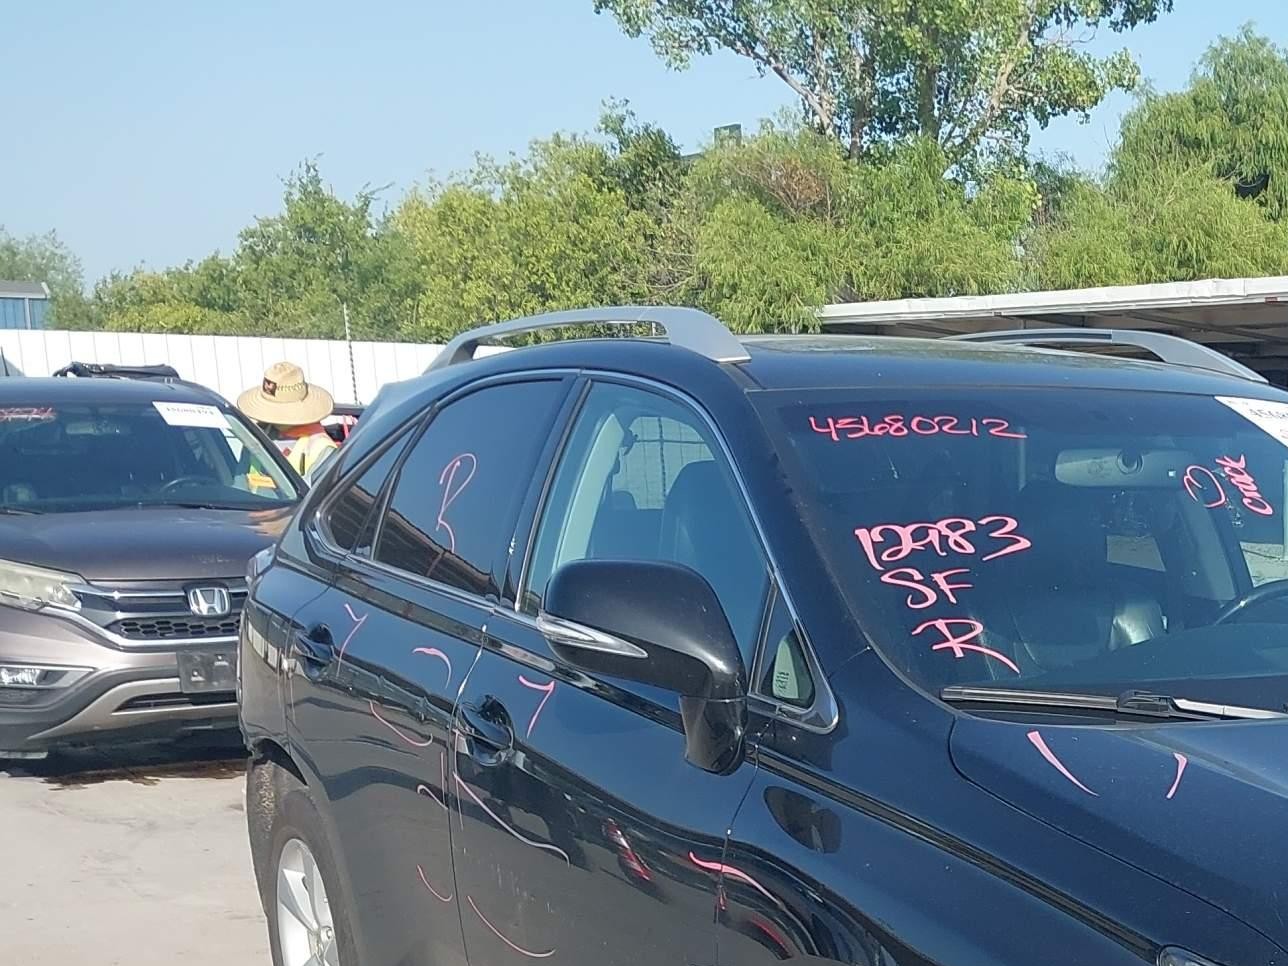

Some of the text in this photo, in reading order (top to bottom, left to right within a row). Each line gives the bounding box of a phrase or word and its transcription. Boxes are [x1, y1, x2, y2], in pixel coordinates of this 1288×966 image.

[808, 414, 1028, 441] 45680212
[879, 567, 974, 609] SF
[911, 618, 1021, 675] R
